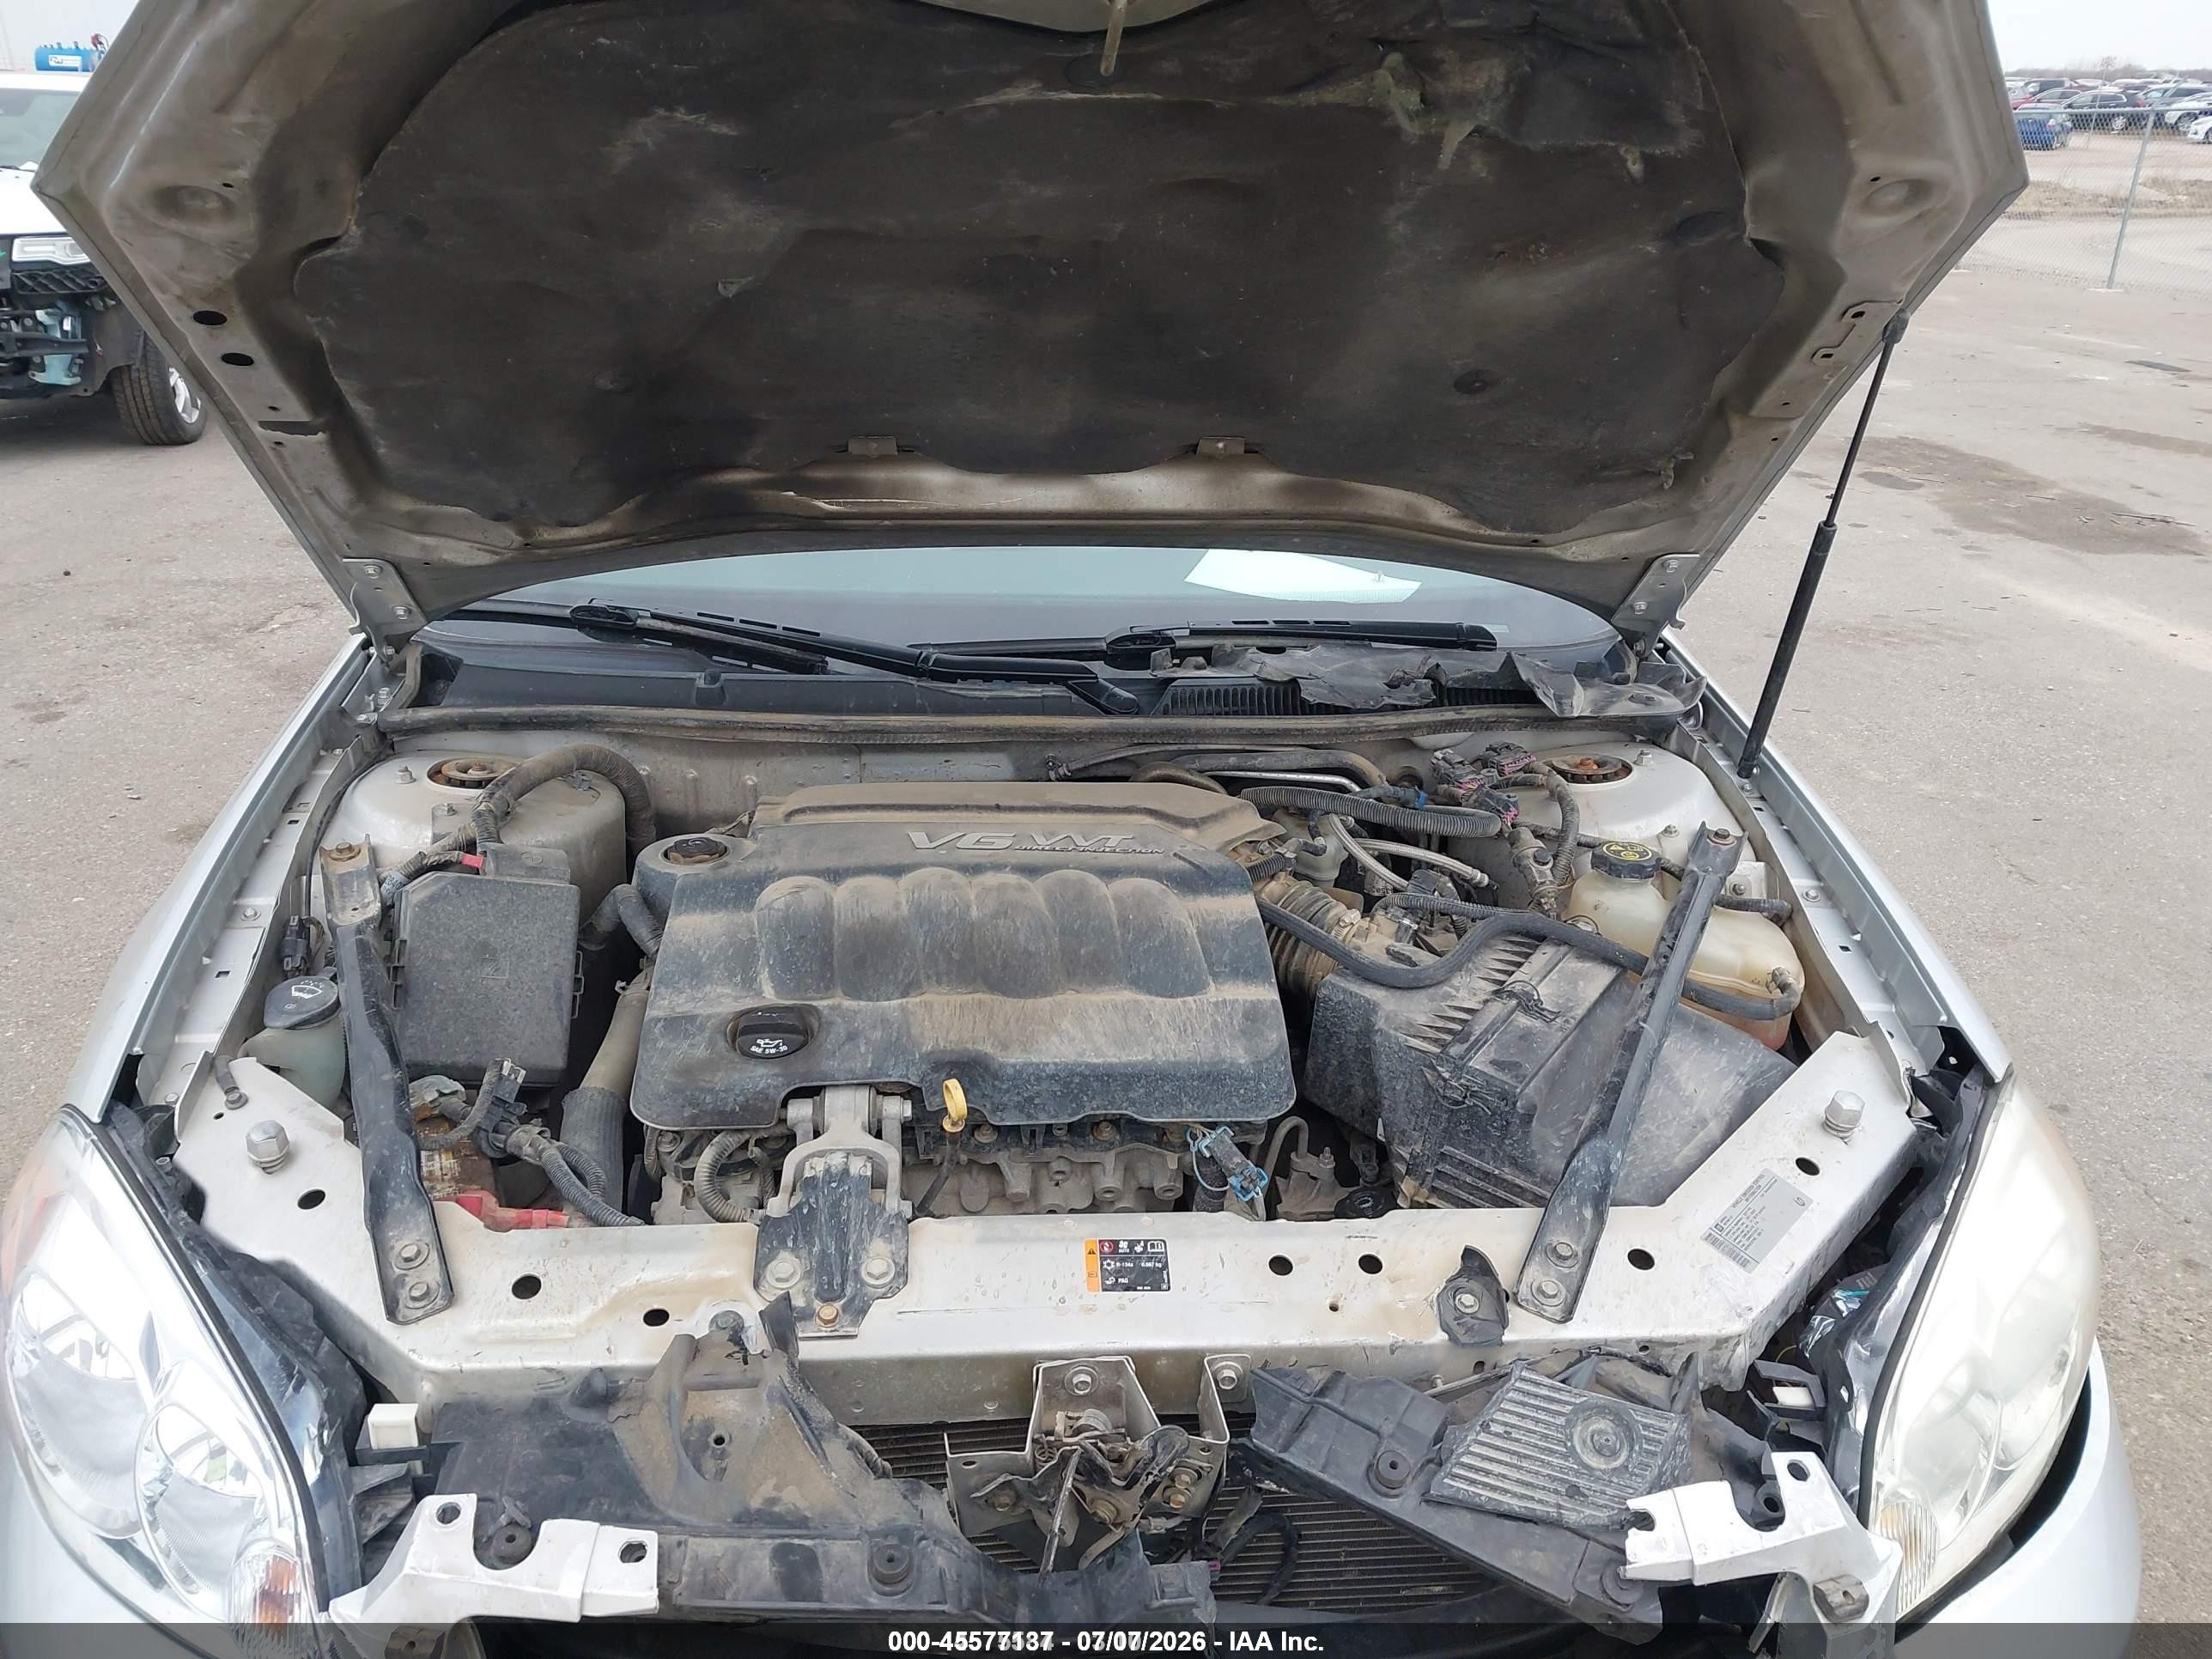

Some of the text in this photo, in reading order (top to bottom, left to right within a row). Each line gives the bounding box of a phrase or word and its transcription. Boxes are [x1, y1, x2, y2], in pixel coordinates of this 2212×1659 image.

[907, 830, 1134, 850] V6 VVT
[750, 1045, 788, 1054] SAE 5W-30
